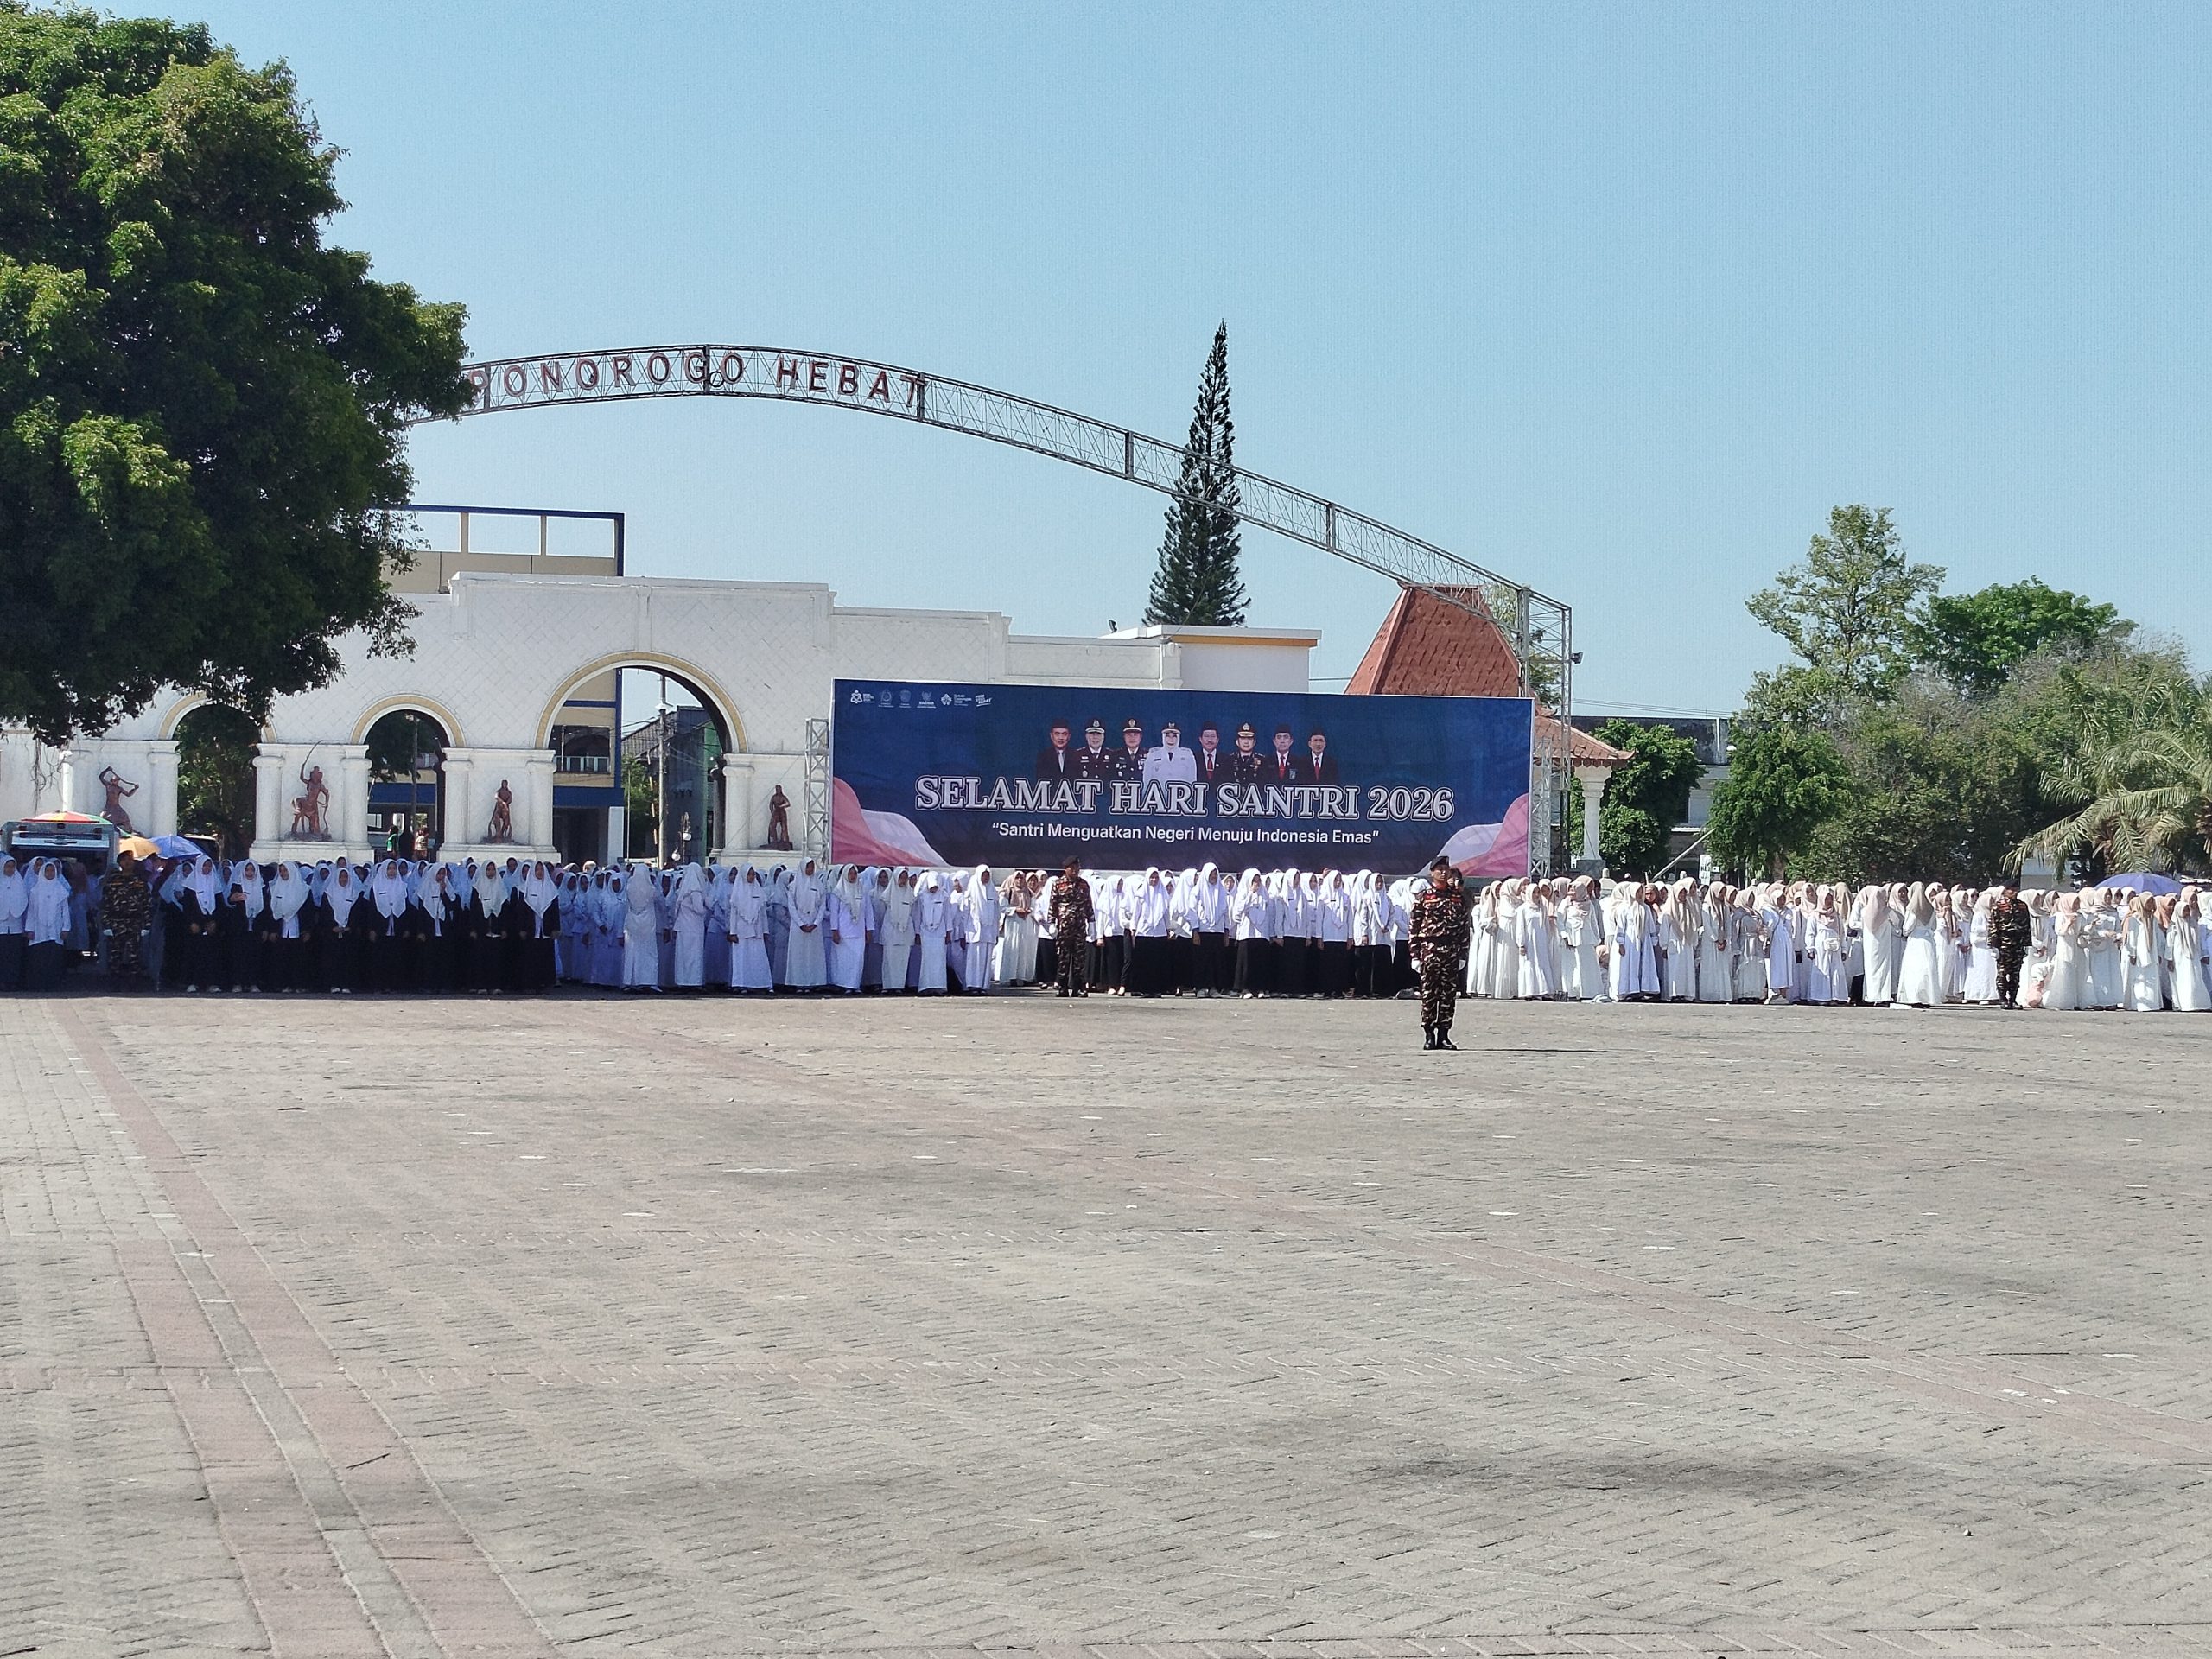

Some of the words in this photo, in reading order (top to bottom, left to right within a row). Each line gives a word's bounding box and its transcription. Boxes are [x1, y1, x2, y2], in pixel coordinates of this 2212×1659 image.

[776, 356, 928, 408] HEBAT
[915, 775, 1103, 814] SELAMAT
[1109, 779, 1208, 817] HARI
[1216, 783, 1360, 820] SANTRI
[1367, 786, 1454, 822] 2026
[1048, 823, 1141, 841] Menguatkan
[1145, 825, 1195, 842] Negeri
[1198, 828, 1253, 844] Menuju
[1257, 829, 1328, 843] Indonesia
